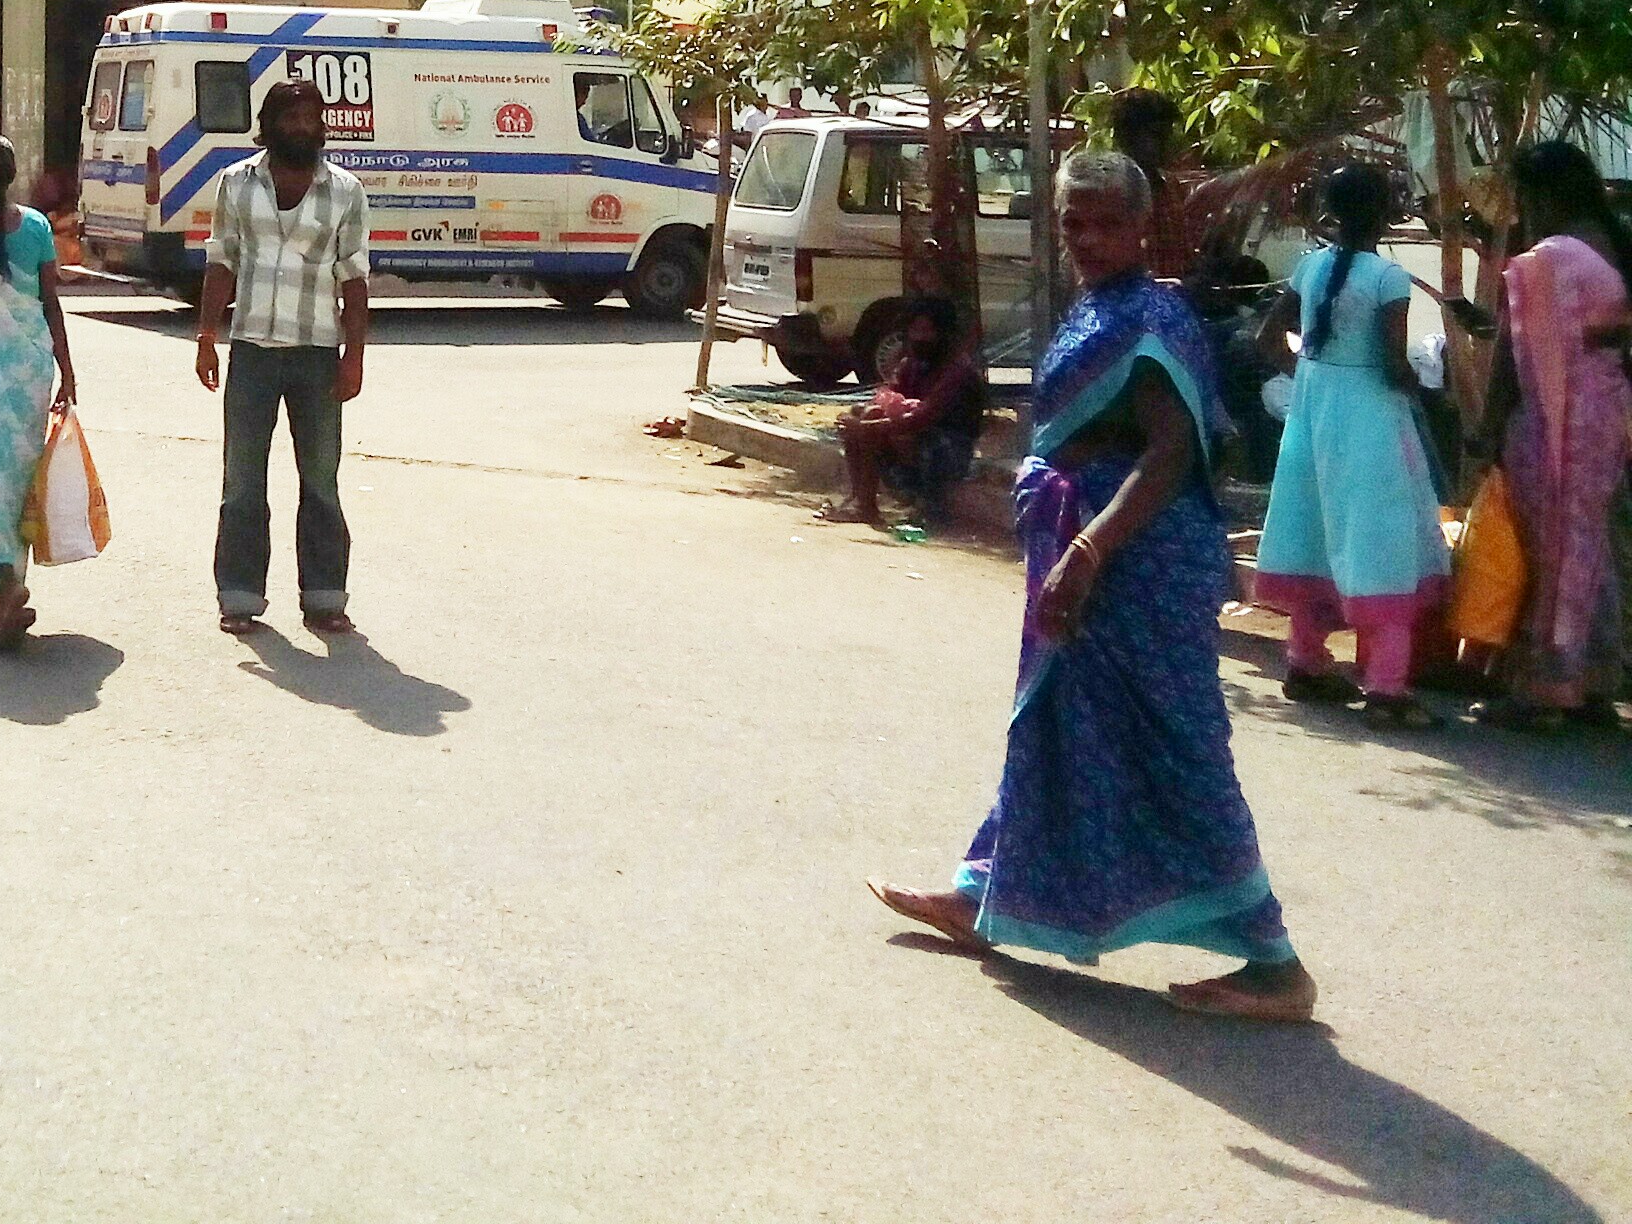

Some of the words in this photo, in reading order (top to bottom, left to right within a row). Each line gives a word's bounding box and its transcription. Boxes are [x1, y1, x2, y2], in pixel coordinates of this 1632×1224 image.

[414, 73, 456, 83] National
[457, 74, 512, 84] Ambulance
[514, 75, 551, 85] Service
[321, 152, 410, 167] மிழ்நாடு
[411, 228, 442, 242] GVK
